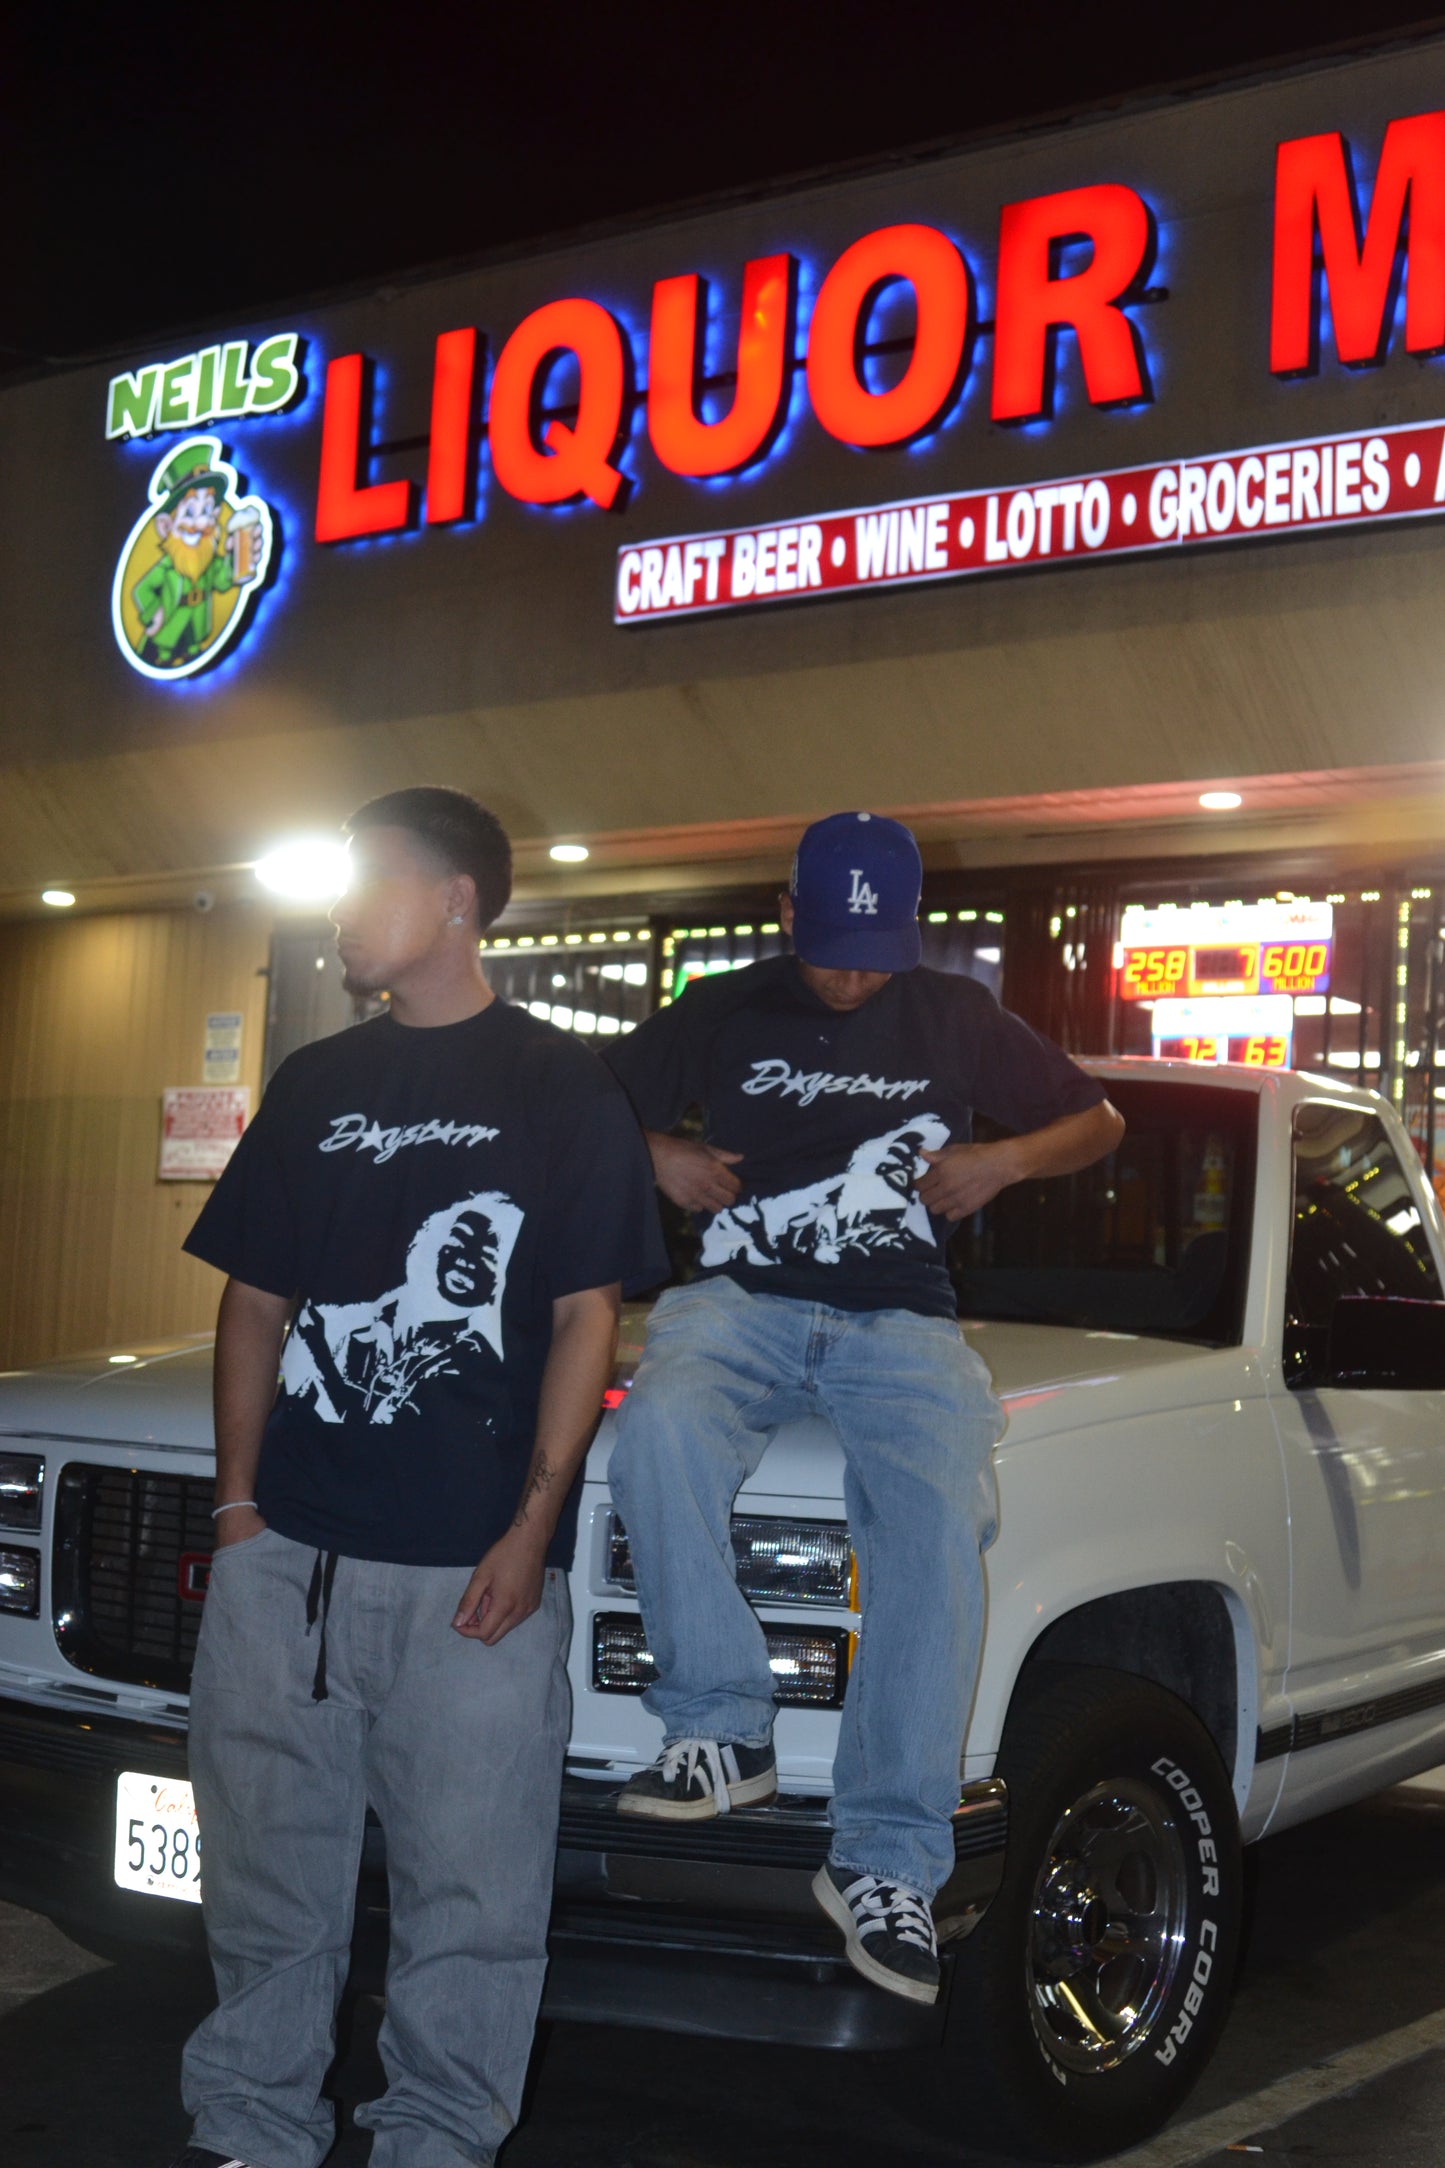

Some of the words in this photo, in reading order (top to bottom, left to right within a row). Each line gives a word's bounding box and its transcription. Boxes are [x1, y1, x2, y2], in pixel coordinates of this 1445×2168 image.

[105, 332, 298, 440] NEILS
[314, 182, 1150, 543] LIQUOR
[617, 538, 726, 614] CRAFT
[731, 524, 822, 598] BEER
[855, 504, 949, 580] WINE
[984, 479, 1110, 562] LOTTO
[1149, 437, 1390, 540] GROCERIES
[847, 869, 879, 915] LA
[1125, 951, 1187, 982] 258
[1262, 944, 1328, 977] 600
[1244, 1035, 1288, 1067] 63
[1151, 1756, 1221, 1897] COOPER
[1154, 1918, 1219, 2067] COBRA
